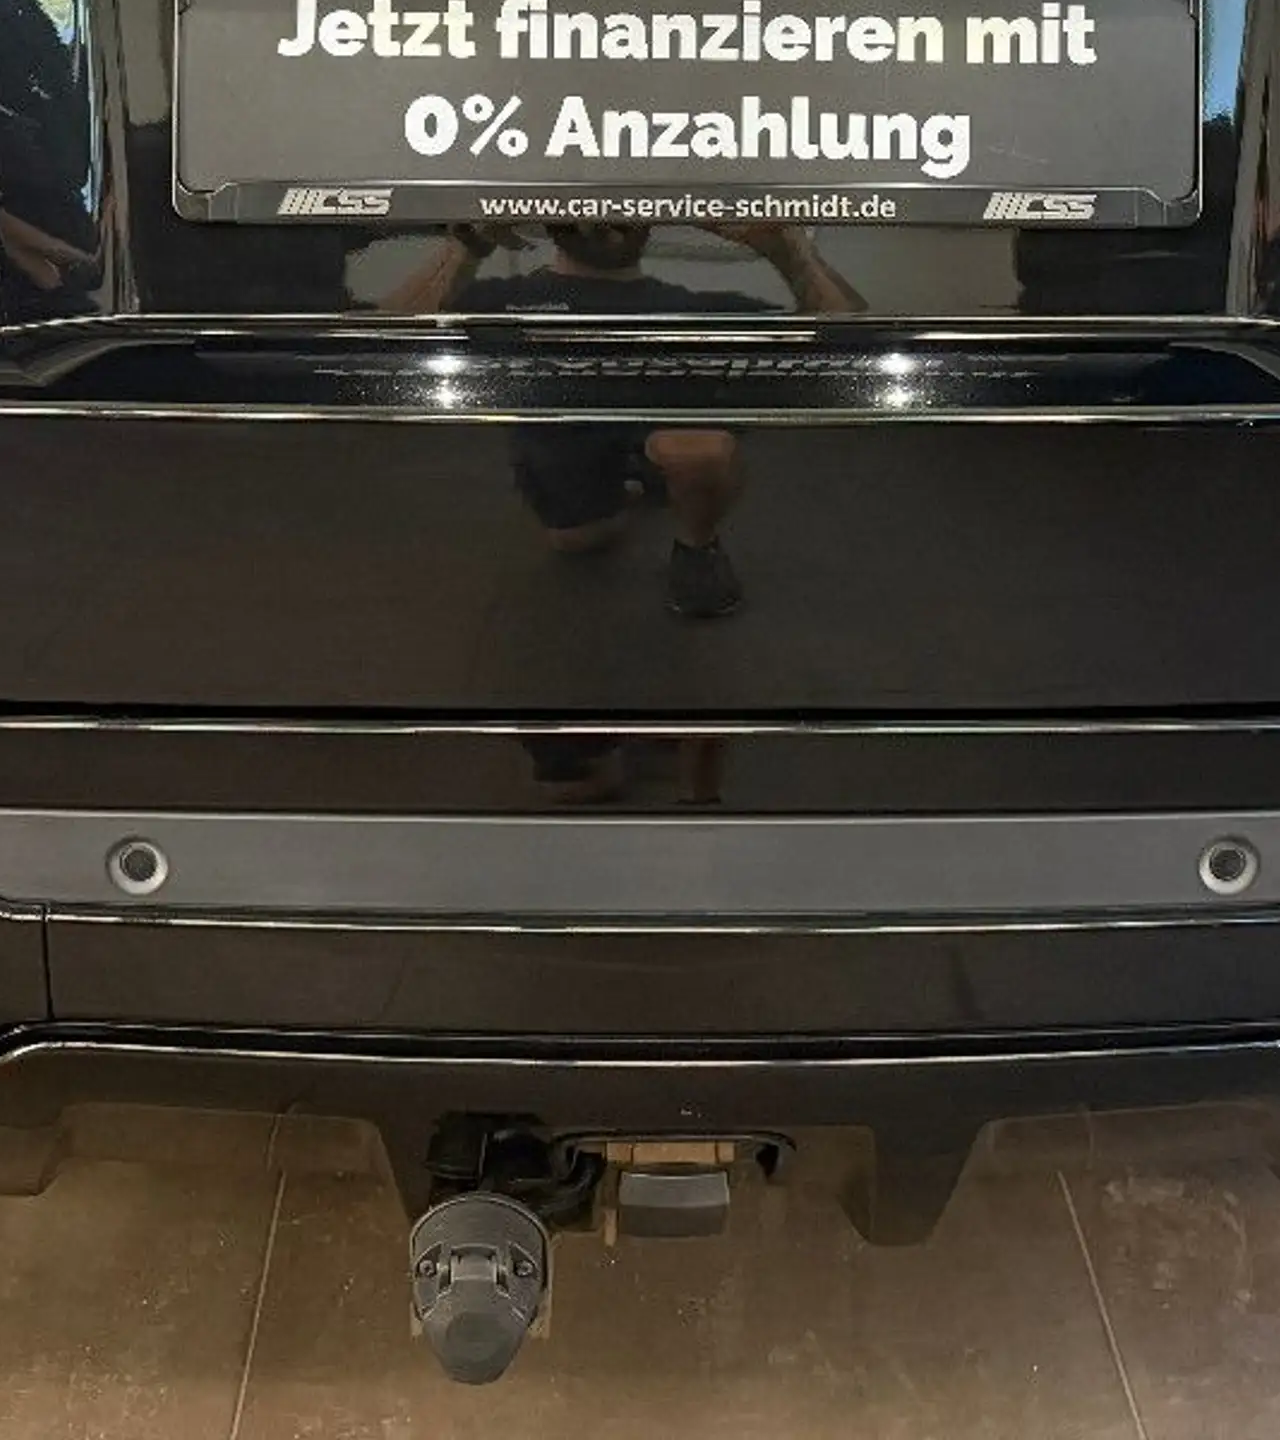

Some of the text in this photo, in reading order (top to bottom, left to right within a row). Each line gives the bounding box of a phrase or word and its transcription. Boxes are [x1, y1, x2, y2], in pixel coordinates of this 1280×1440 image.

[967, 3, 1097, 65] mit
[405, 94, 970, 178] 0% Anzahlung
[480, 195, 896, 218] www.car-service-schmidt.de
